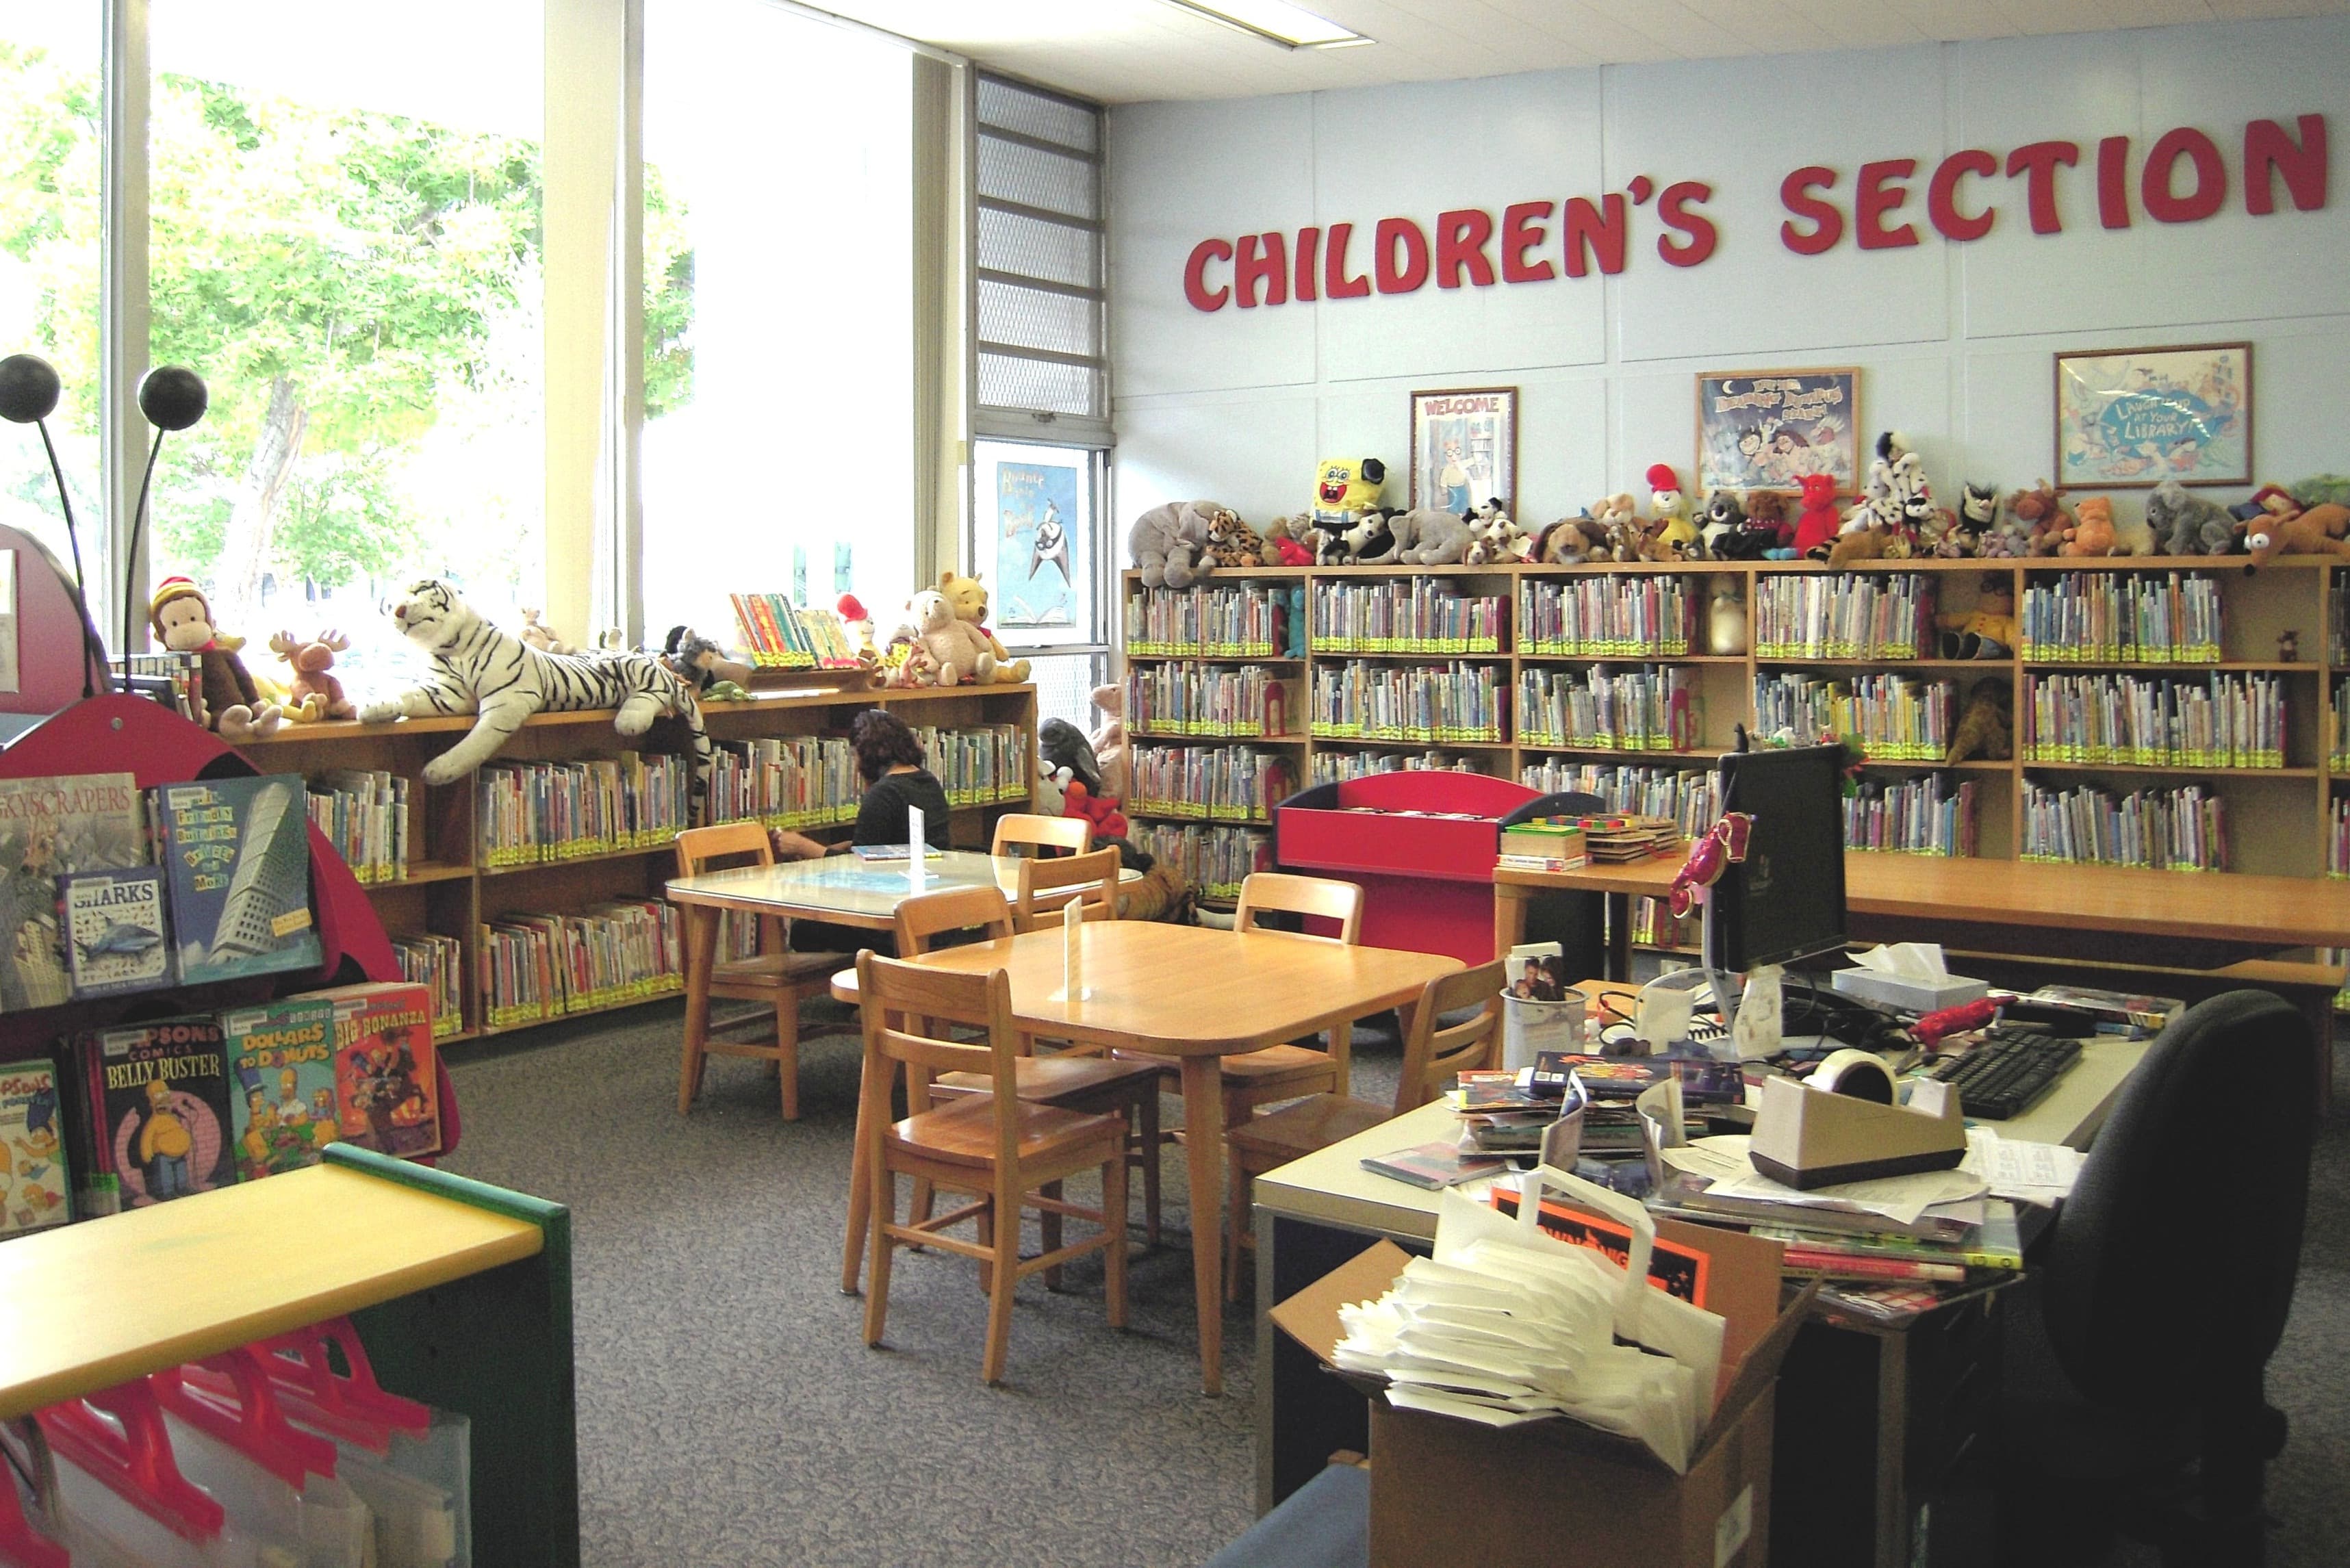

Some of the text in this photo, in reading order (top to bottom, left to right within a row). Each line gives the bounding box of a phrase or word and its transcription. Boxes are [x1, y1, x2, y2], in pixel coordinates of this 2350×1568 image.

[1183, 114, 2327, 313] CHILDREN'S SECTION
[1425, 397, 1499, 416] WELCOME
[2115, 398, 2158, 420] LAUGH
[2134, 411, 2178, 422] AT YOUR
[2124, 420, 2194, 439] LIBRARY!
[0, 786, 131, 819] KYSCRAPERS
[363, 1010, 426, 1038] BONANZA
[129, 1045, 192, 1061] COMICS
[258, 1043, 330, 1068] DONUTS
[106, 1053, 220, 1090] BELLY BUSTER
